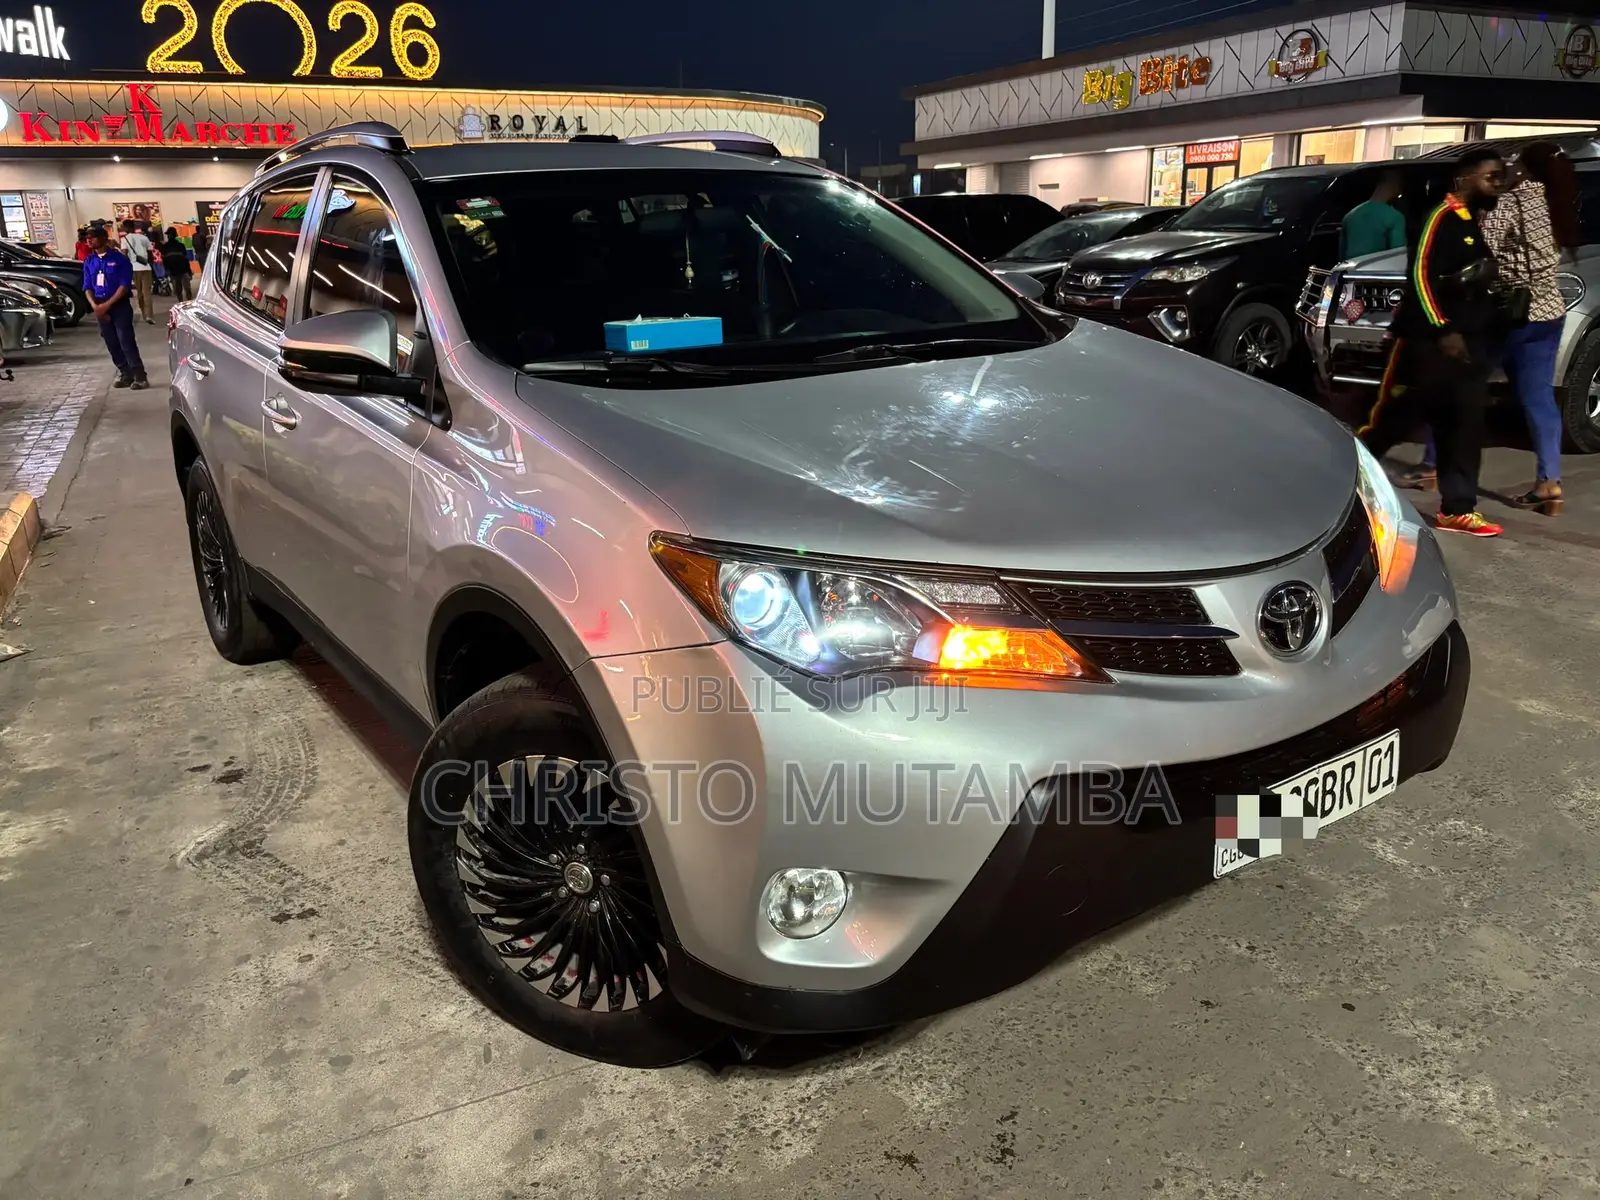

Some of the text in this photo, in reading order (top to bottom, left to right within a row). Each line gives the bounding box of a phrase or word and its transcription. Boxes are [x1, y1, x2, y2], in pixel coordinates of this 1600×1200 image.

[141, 0, 441, 81] 2026
[1082, 55, 1212, 111] Big Bite
[17, 111, 297, 144] KIN MARCHE
[488, 114, 588, 132] ROYAL
[1190, 141, 1235, 154] LIVRAISON
[1367, 740, 1395, 795] 01
